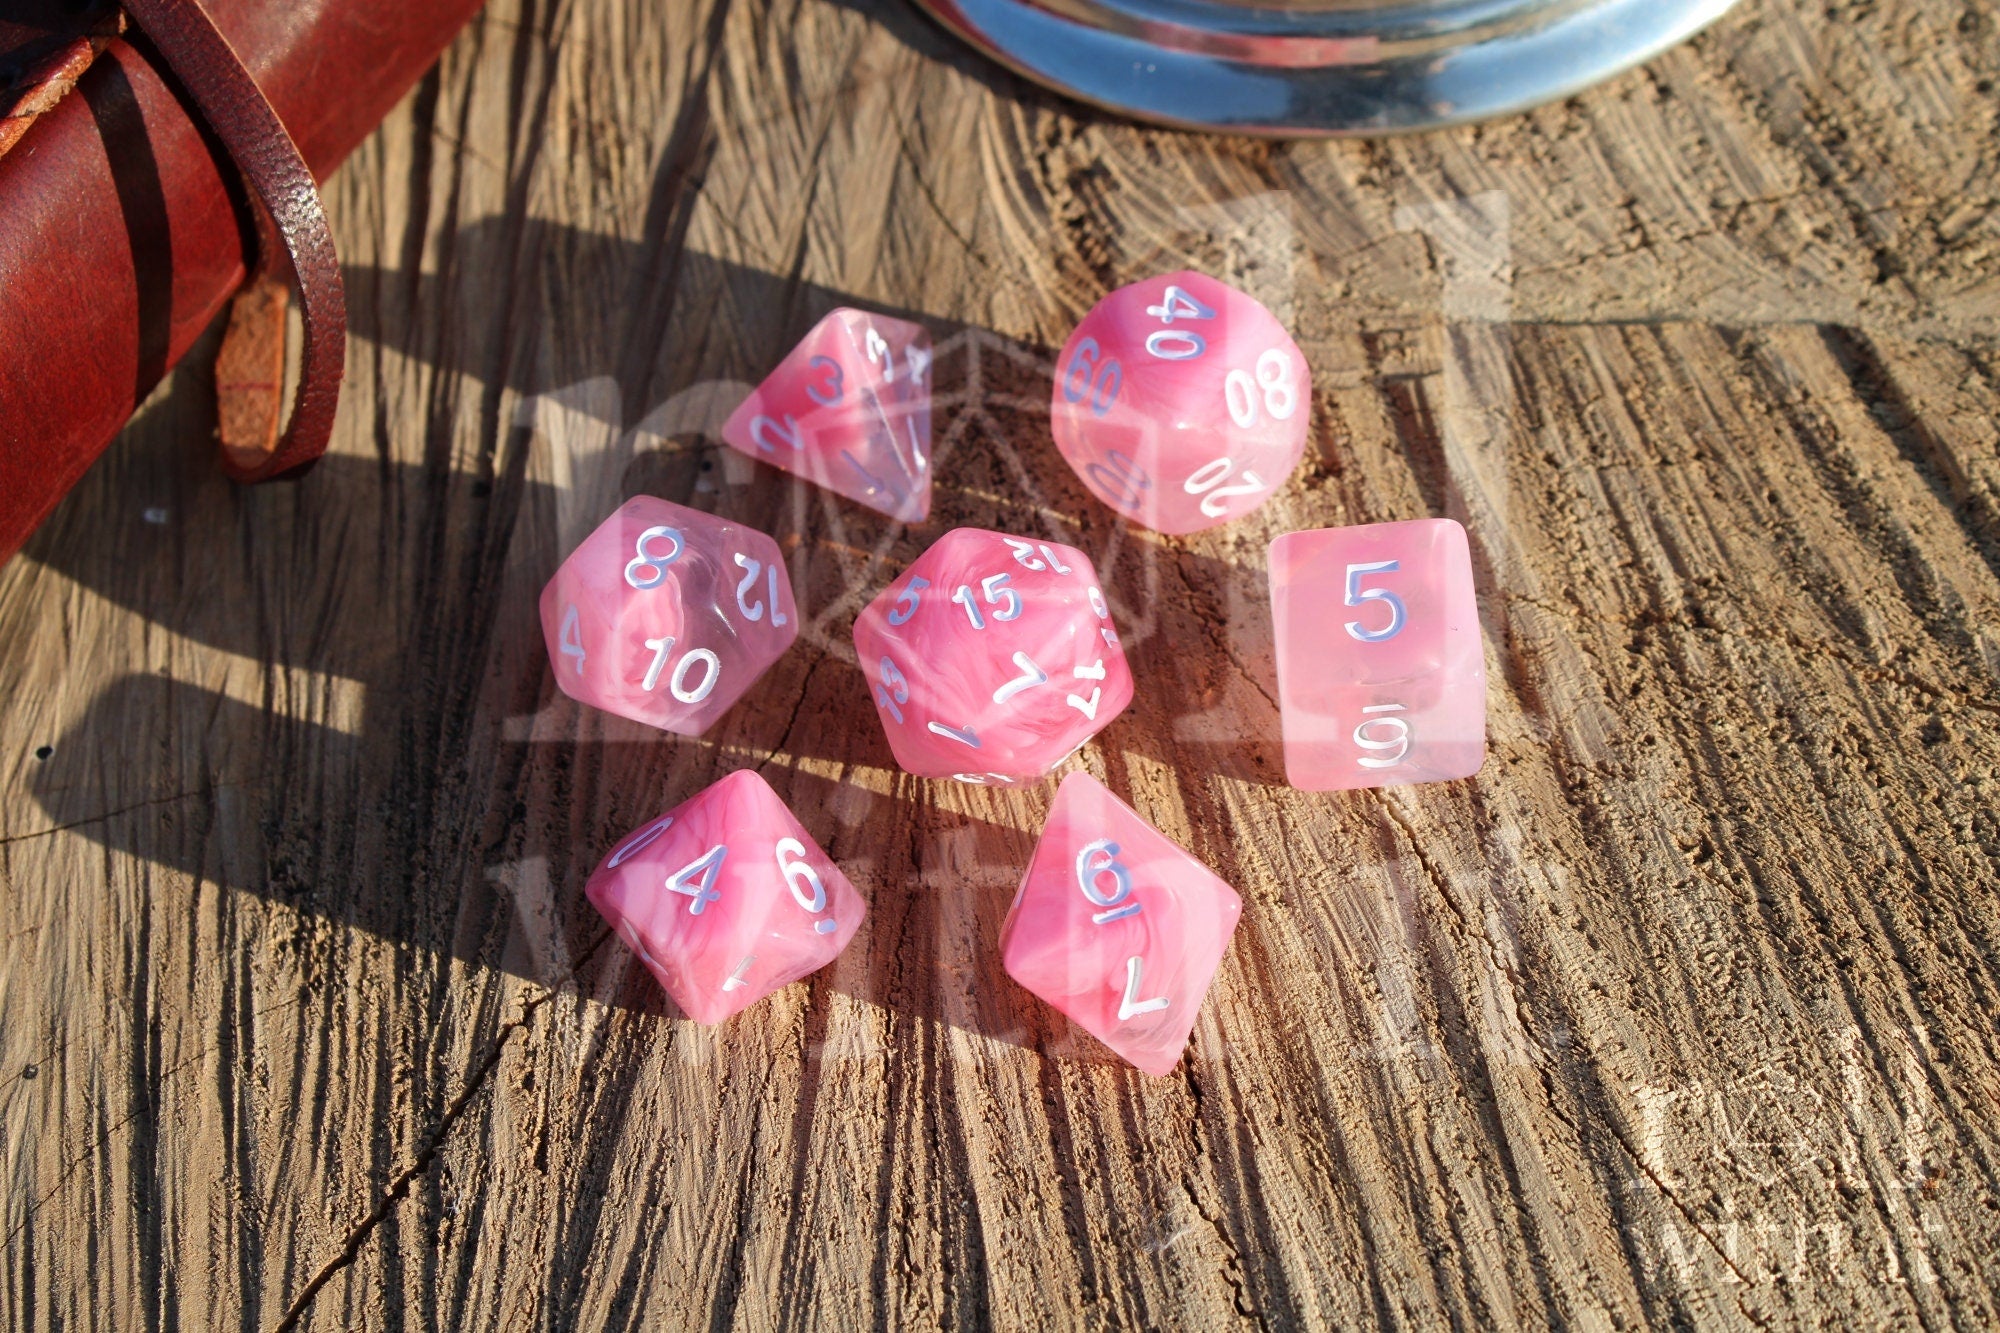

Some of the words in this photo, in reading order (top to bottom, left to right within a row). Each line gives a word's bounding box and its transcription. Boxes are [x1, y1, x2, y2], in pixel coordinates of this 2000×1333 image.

[1146, 286, 1216, 360] 40
[806, 355, 845, 408] 3
[1063, 336, 1123, 417] 60
[1225, 348, 1296, 429] 80
[750, 414, 804, 452] 2
[1184, 457, 1267, 518] 20
[624, 526, 686, 590] 8
[734, 552, 787, 628] 12
[888, 574, 930, 626] 5
[952, 572, 1024, 630] 15
[1344, 559, 1408, 643] 5
[559, 603, 586, 676] 4
[641, 636, 722, 704] 10
[876, 655, 909, 725] 13
[992, 651, 1048, 704] 7
[665, 844, 728, 915] 4
[1118, 956, 1169, 1021] 7
